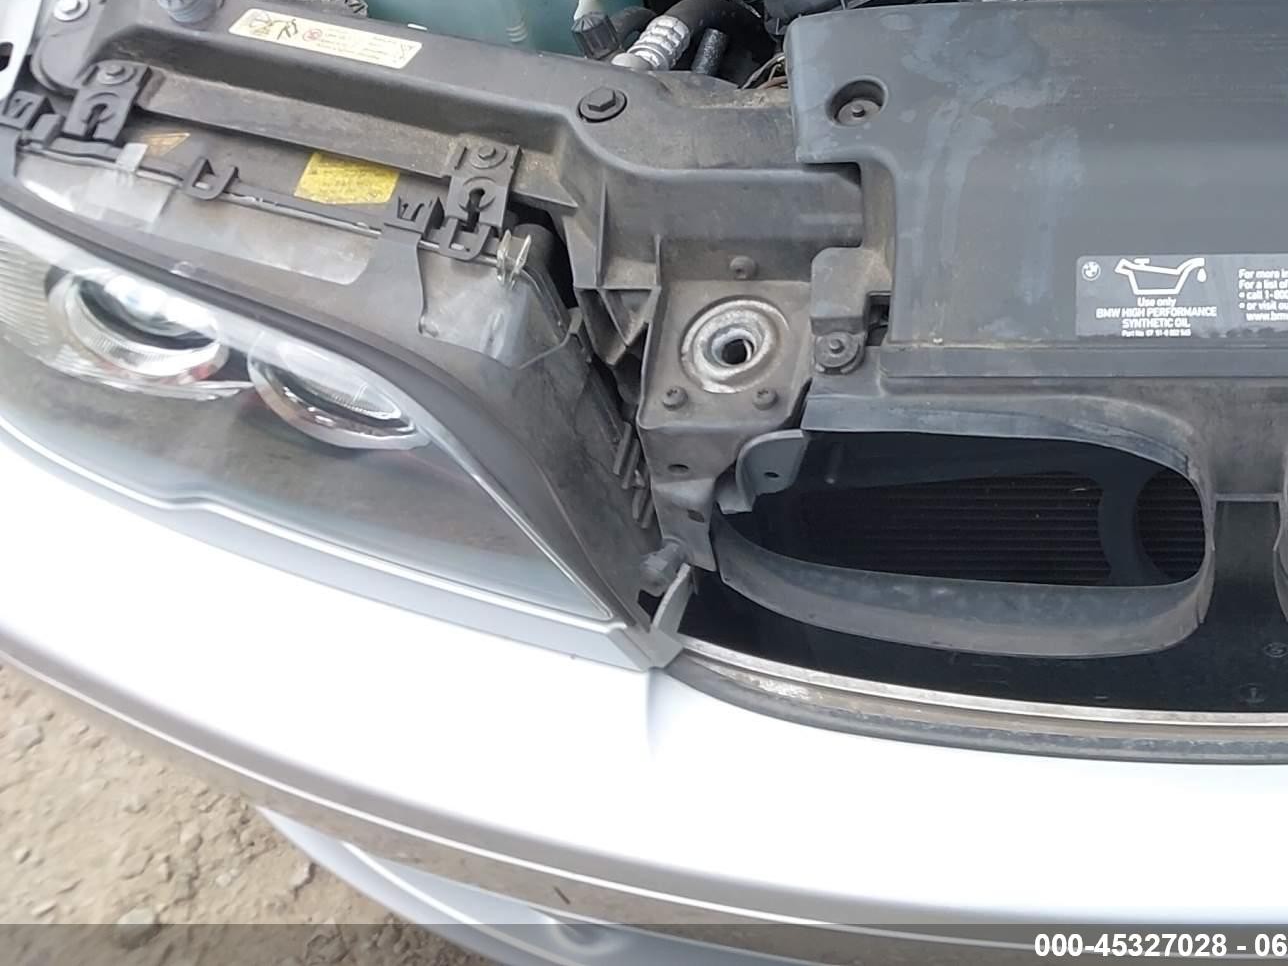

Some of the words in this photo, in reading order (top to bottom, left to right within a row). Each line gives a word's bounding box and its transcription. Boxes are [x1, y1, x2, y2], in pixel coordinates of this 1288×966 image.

[1238, 268, 1255, 279] For
[1256, 270, 1280, 278] more
[1238, 279, 1255, 290] For
[1255, 281, 1263, 289] a
[1264, 279, 1278, 289] list
[1279, 279, 1288, 289] of
[1246, 290, 1263, 300] call
[1137, 297, 1155, 307] Use
[1156, 297, 1177, 307] only
[1246, 302, 1257, 310] or
[1258, 301, 1277, 310] visit
[1096, 308, 1121, 318] BMW
[1122, 307, 1145, 318] HIGH
[1146, 306, 1217, 317] PERFORMANCE
[1122, 318, 1174, 328] SYNTHETIC
[1174, 318, 1191, 328] OIL
